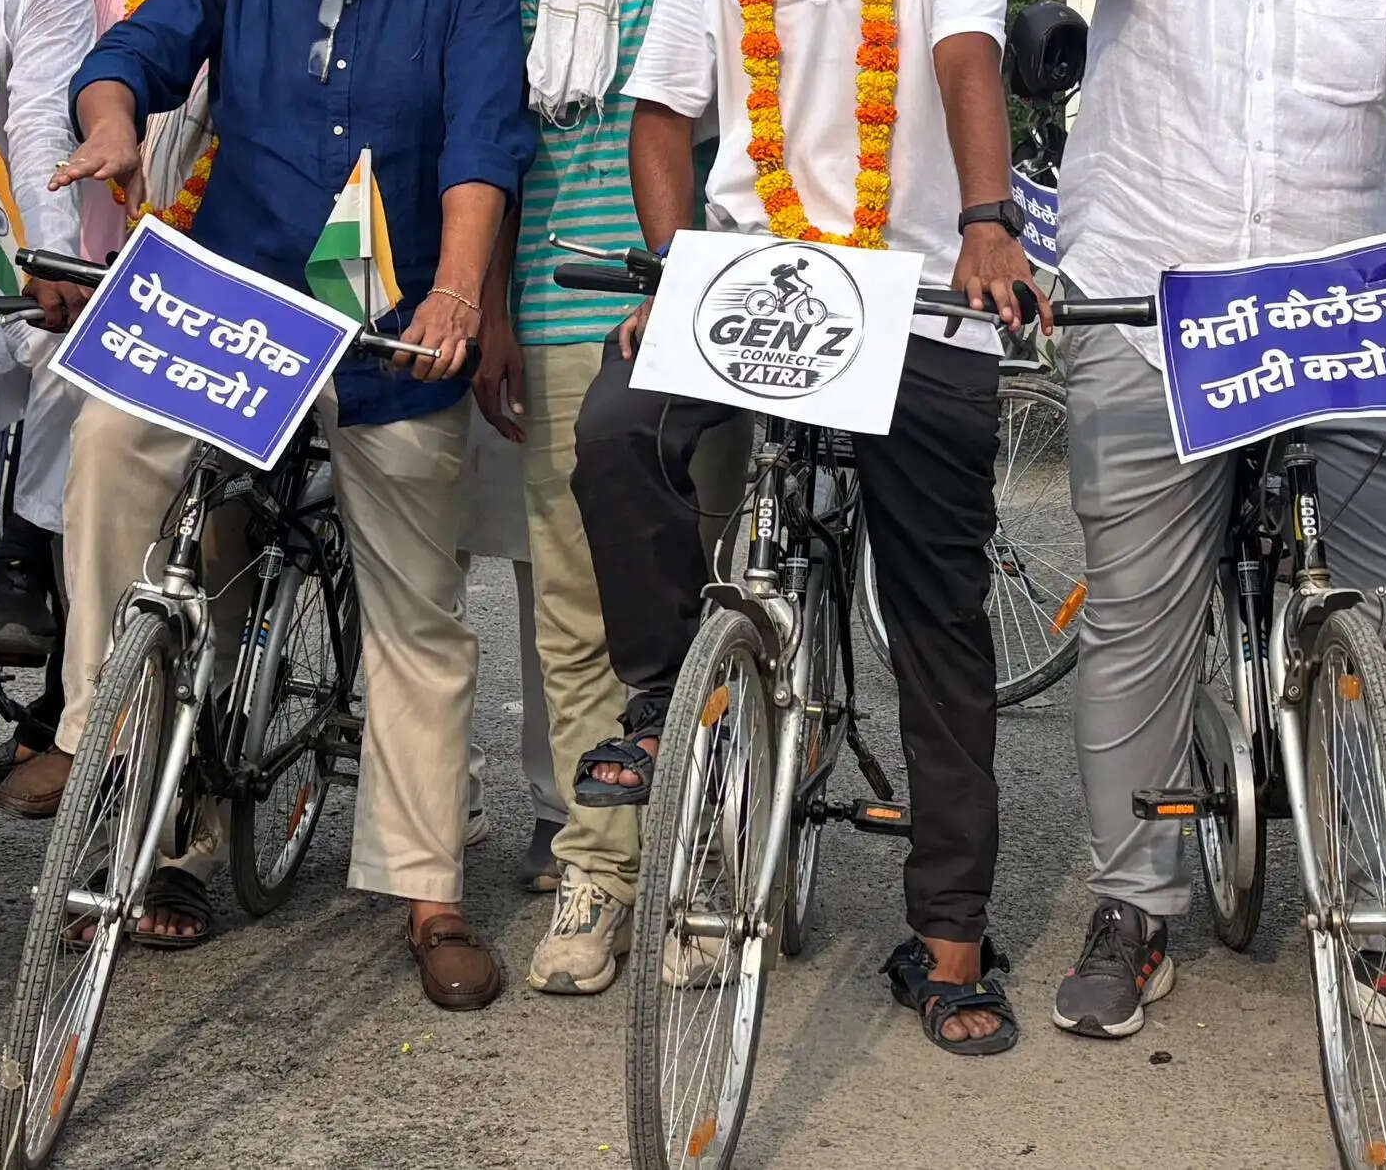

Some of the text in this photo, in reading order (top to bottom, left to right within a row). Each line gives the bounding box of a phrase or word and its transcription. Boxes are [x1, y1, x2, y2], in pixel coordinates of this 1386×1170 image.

[130, 272, 311, 377] पेपर लीक
[709, 315, 853, 356] GEN Z
[1179, 295, 1259, 349] भर्ती
[101, 322, 269, 420] बंद करो!
[738, 364, 807, 387] YATRA
[740, 349, 817, 367] CONNECT
[1200, 348, 1297, 409] जारी
